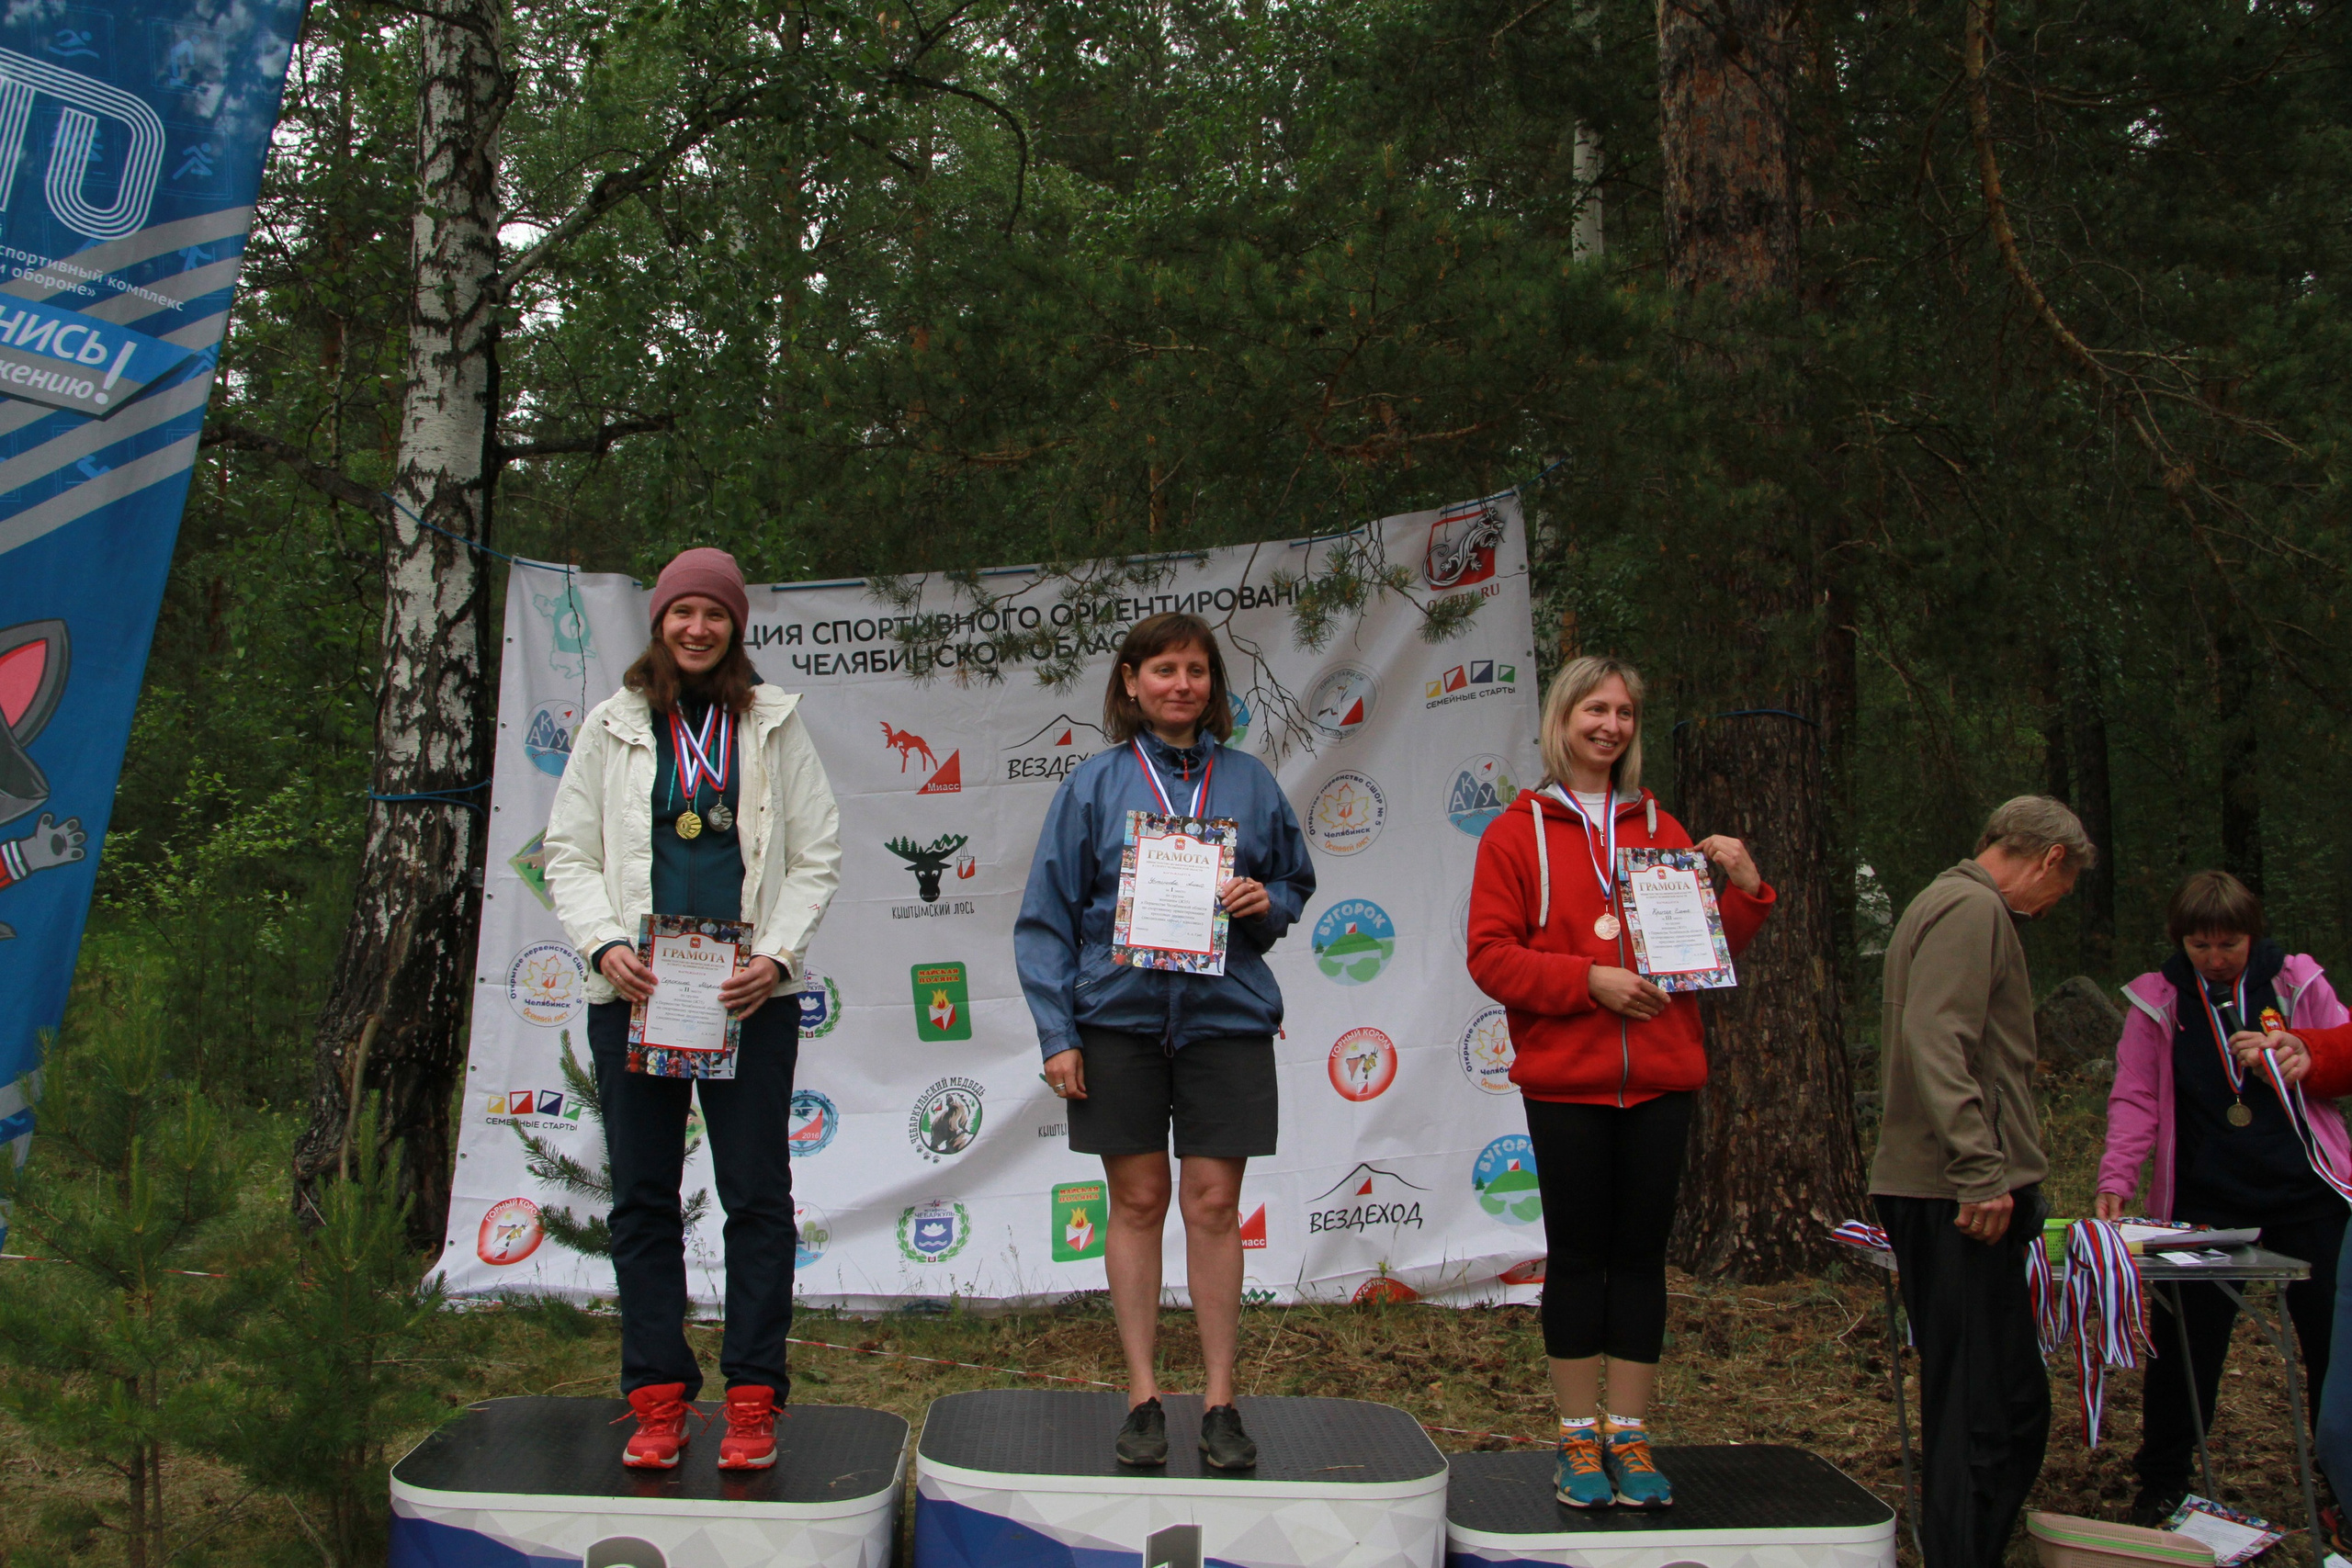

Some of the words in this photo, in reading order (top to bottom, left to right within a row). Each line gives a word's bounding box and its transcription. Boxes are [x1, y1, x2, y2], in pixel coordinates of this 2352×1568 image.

[12, 266, 96, 297] обороне»
[107, 276, 185, 311] комплекс
[1426, 693, 1476, 709] СЕМЕЙНЫЕ
[1479, 686, 1516, 698] СТАРТЫ
[927, 782, 960, 792] Миасс
[1365, 781, 1383, 805] СШОР
[1324, 827, 1371, 839] Челябинск
[1147, 850, 1210, 865] ГРАМОТА
[1639, 881, 1690, 892] ГРАМОТА
[891, 902, 951, 919] КЫШТЫМСКИЙ
[954, 901, 975, 915] ЛОСЬ
[1318, 902, 1386, 937] БУГОРОК
[662, 948, 725, 964] ГРАМОТА
[510, 958, 525, 999] Открытое
[524, 945, 572, 958] первенство
[918, 968, 959, 976] МАЙСКАЯ
[918, 976, 959, 984] ПОЛЯНА
[525, 998, 571, 1008] Челябинск
[1331, 1029, 1361, 1058] ГОРНЫЙ
[1363, 1029, 1391, 1050] КОРОЛЬ
[1463, 1027, 1474, 1072] Открытое
[909, 1077, 948, 1145] ЧЕБАРКУЛЬСКИЙ
[950, 1077, 986, 1097] МЕДВЕДЬ
[486, 1117, 539, 1129] СЕМЕНЫЕ
[542, 1122, 578, 1131] СТАРТЫ
[485, 1198, 518, 1223] ГОРНЫЙ
[1309, 1201, 1423, 1234] ВЕЗДЕХОД
[1241, 1238, 1265, 1247] иасс
